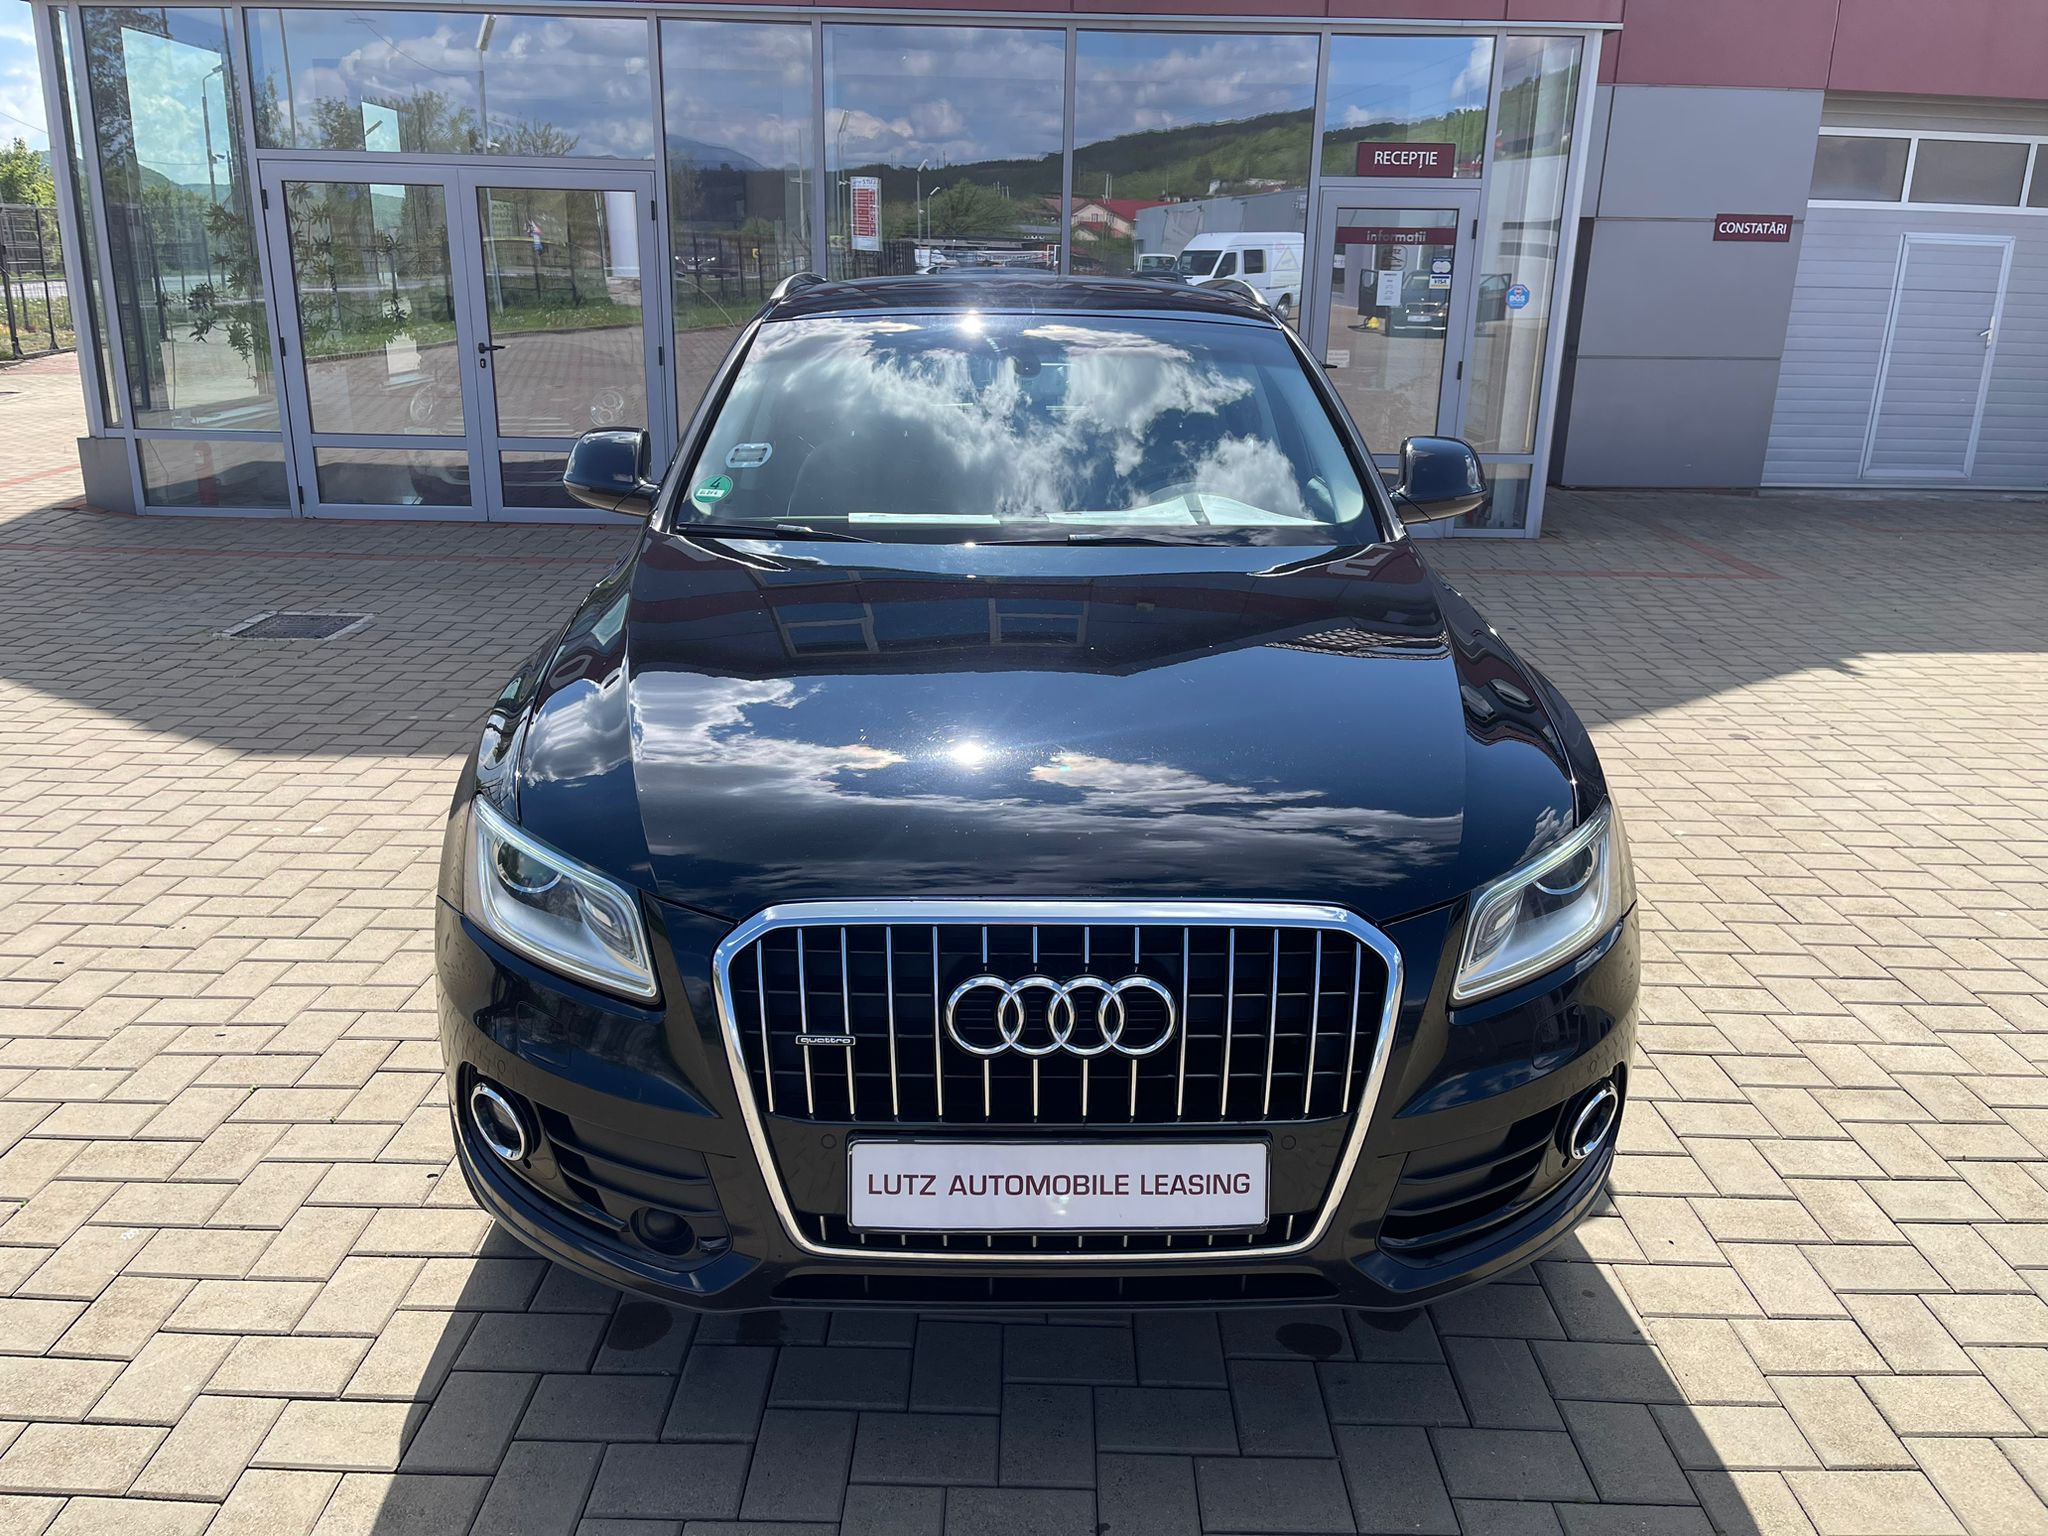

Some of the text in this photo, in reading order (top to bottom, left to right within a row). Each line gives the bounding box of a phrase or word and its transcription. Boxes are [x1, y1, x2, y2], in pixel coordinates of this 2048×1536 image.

[1374, 151, 1438, 168] RECEPȚIE
[1719, 222, 1787, 234] CONSTATĂRI
[710, 477, 721, 489] 4
[868, 1173, 1251, 1196] LUTZ AUTOMOBILE LEASING
